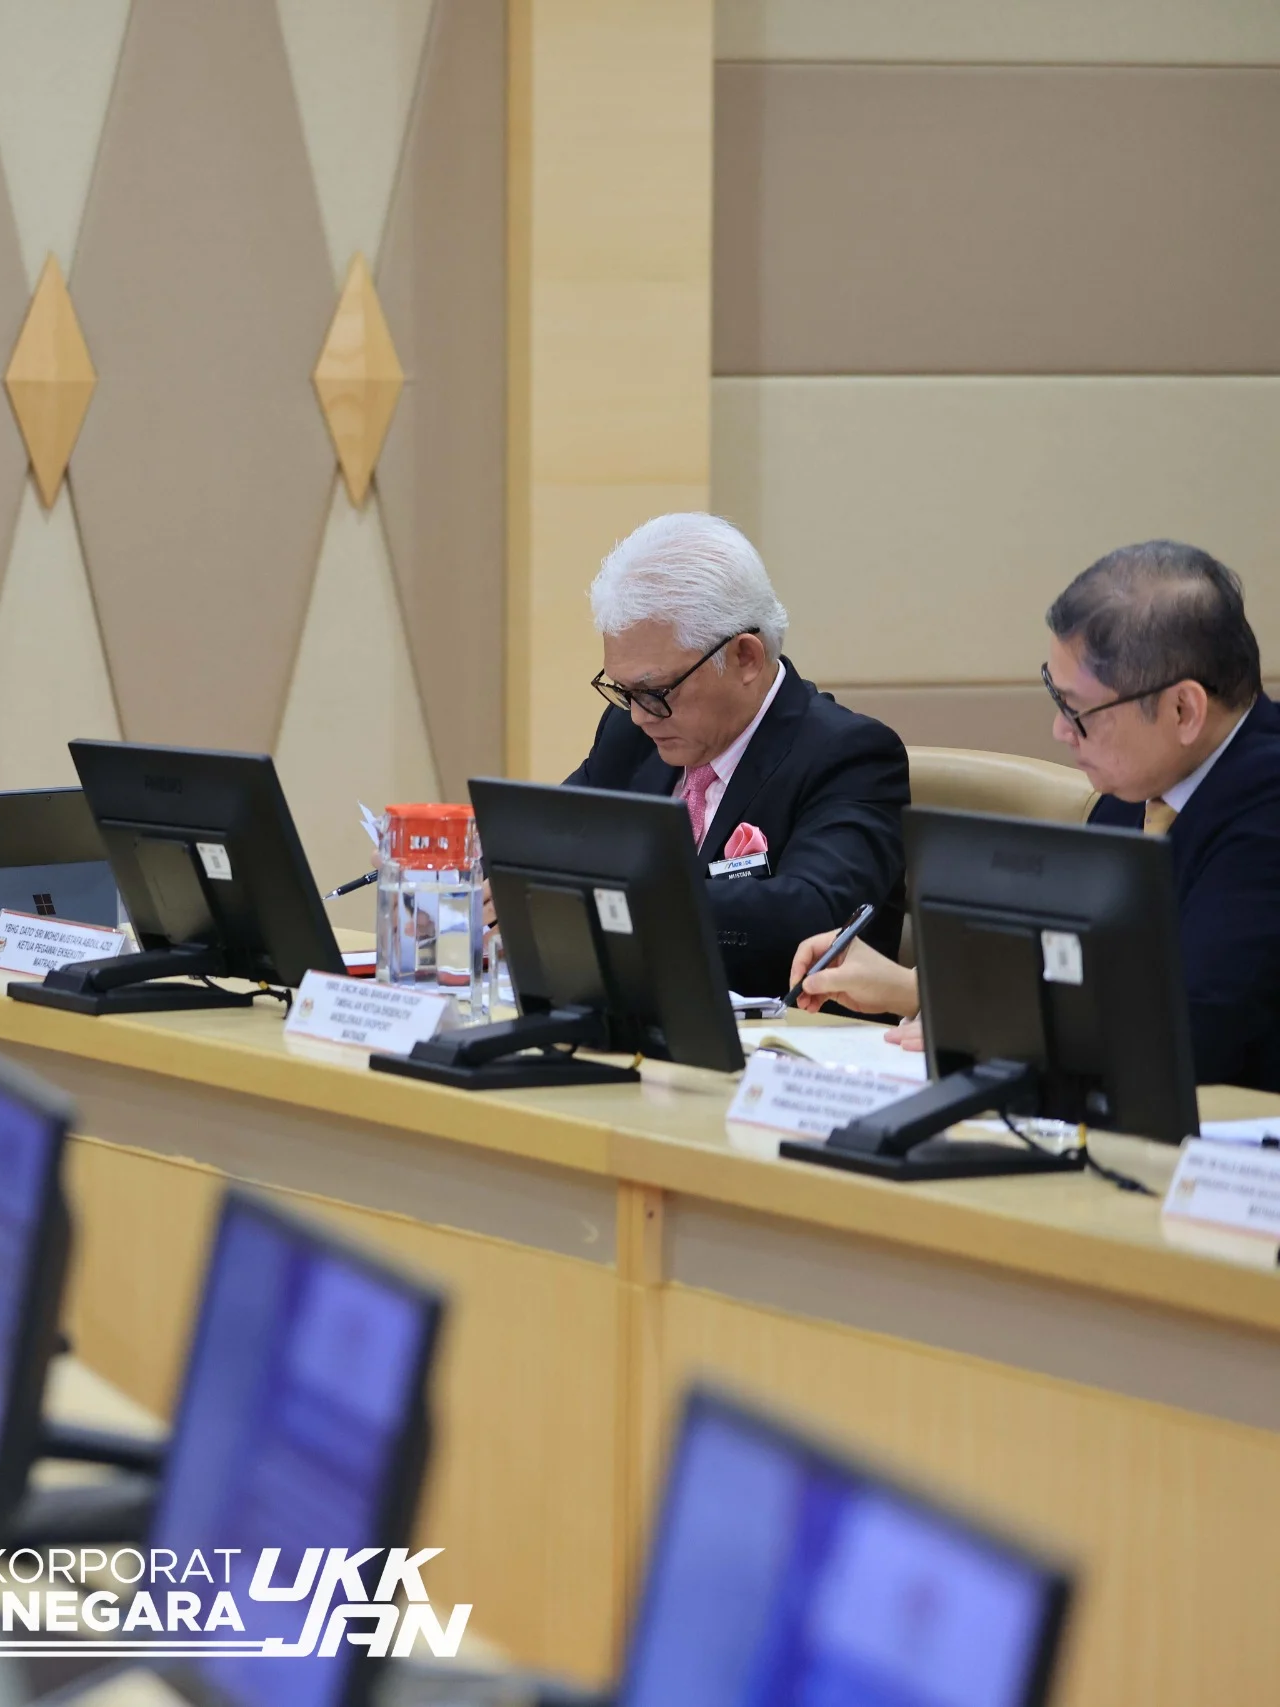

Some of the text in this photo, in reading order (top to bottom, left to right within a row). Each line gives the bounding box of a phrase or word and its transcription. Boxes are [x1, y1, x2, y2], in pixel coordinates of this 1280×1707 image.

[728, 870, 752, 880] MUSTAFA
[43, 929, 59, 942] MOHD
[17, 940, 35, 952] KETUA
[34, 942, 58, 956] PEGAWAI
